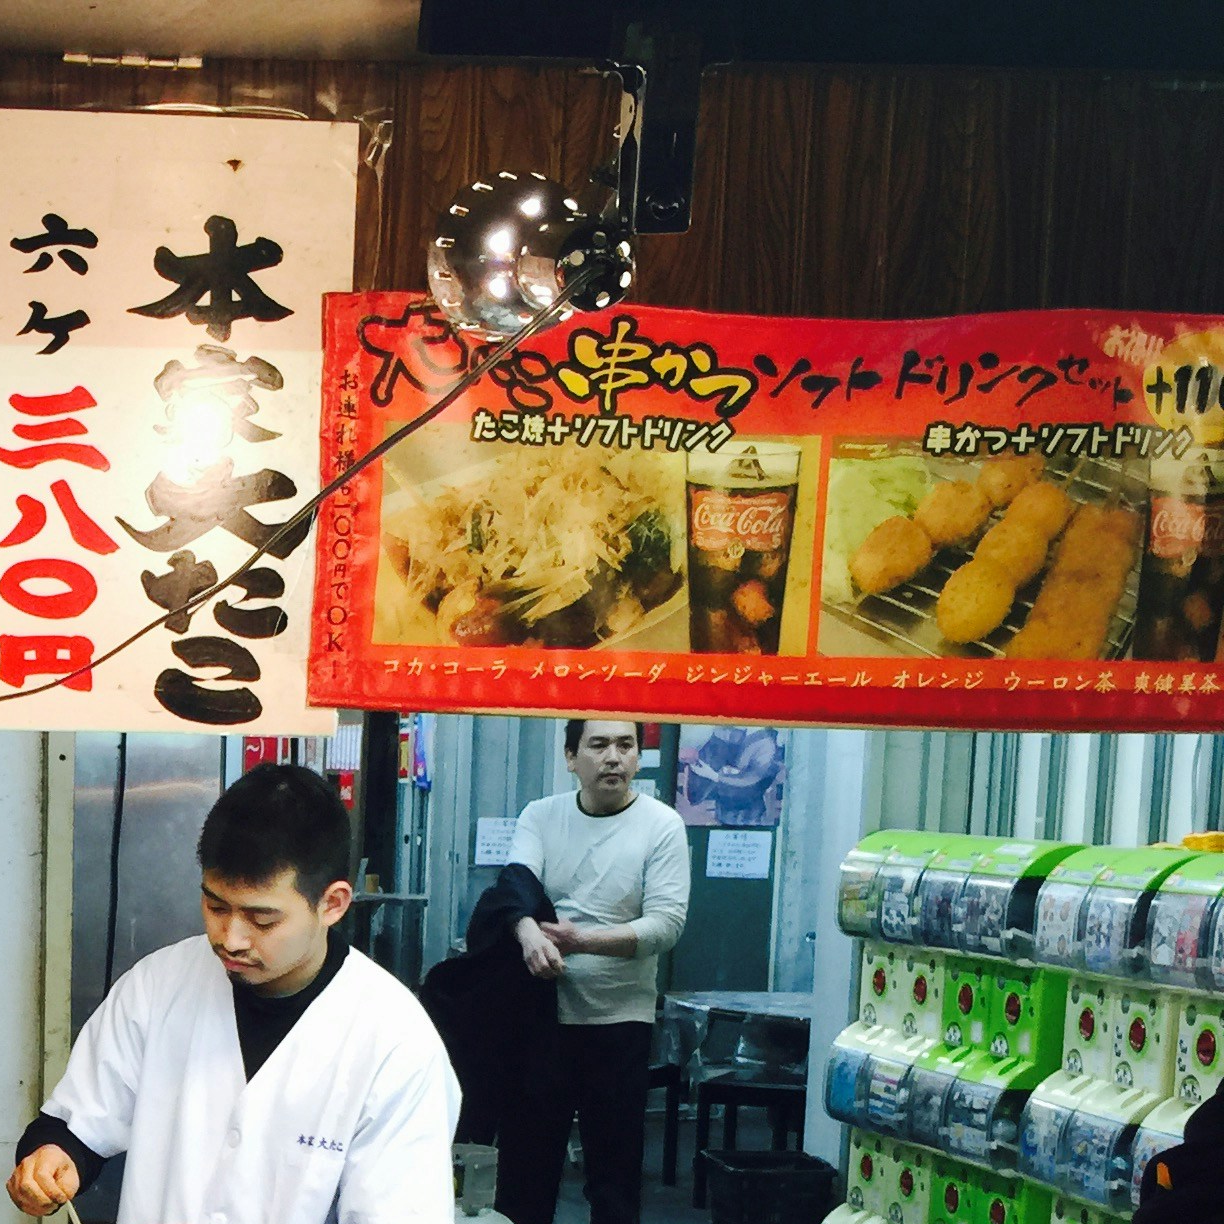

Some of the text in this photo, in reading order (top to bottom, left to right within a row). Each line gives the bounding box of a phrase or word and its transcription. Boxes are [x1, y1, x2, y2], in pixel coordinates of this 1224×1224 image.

[1146, 363, 1224, 415] +11
[382, 659, 1222, 697] コカ・コーラ メロンソーダ ジンジャーエール オレンジ ウーロン茶 爽健美茶
